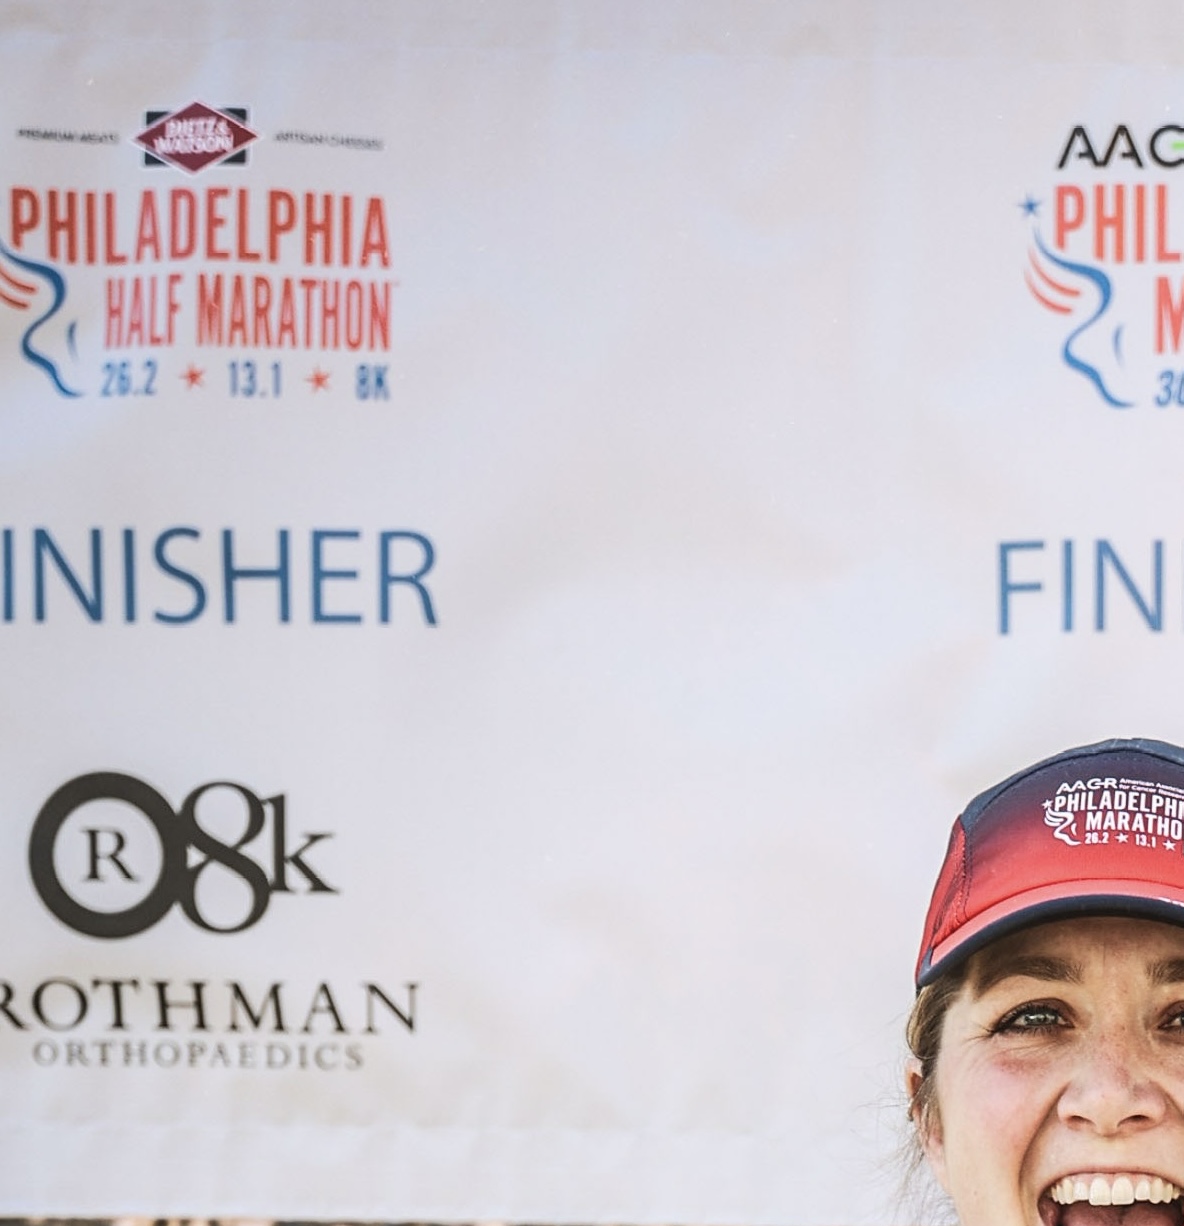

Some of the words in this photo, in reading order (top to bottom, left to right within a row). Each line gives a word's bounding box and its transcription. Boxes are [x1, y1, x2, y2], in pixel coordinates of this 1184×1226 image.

[10, 187, 391, 268] PHILADELPHIA
[104, 273, 184, 349] HALF
[196, 273, 392, 351] MARATHON
[101, 360, 158, 397] 26.2
[228, 360, 283, 398] 13.1
[355, 363, 390, 400] 8K
[1084, 832, 1109, 845] 26.2
[1135, 833, 1157, 849] 13.1
[32, 1038, 365, 1071] ORTHOPAEDICS
